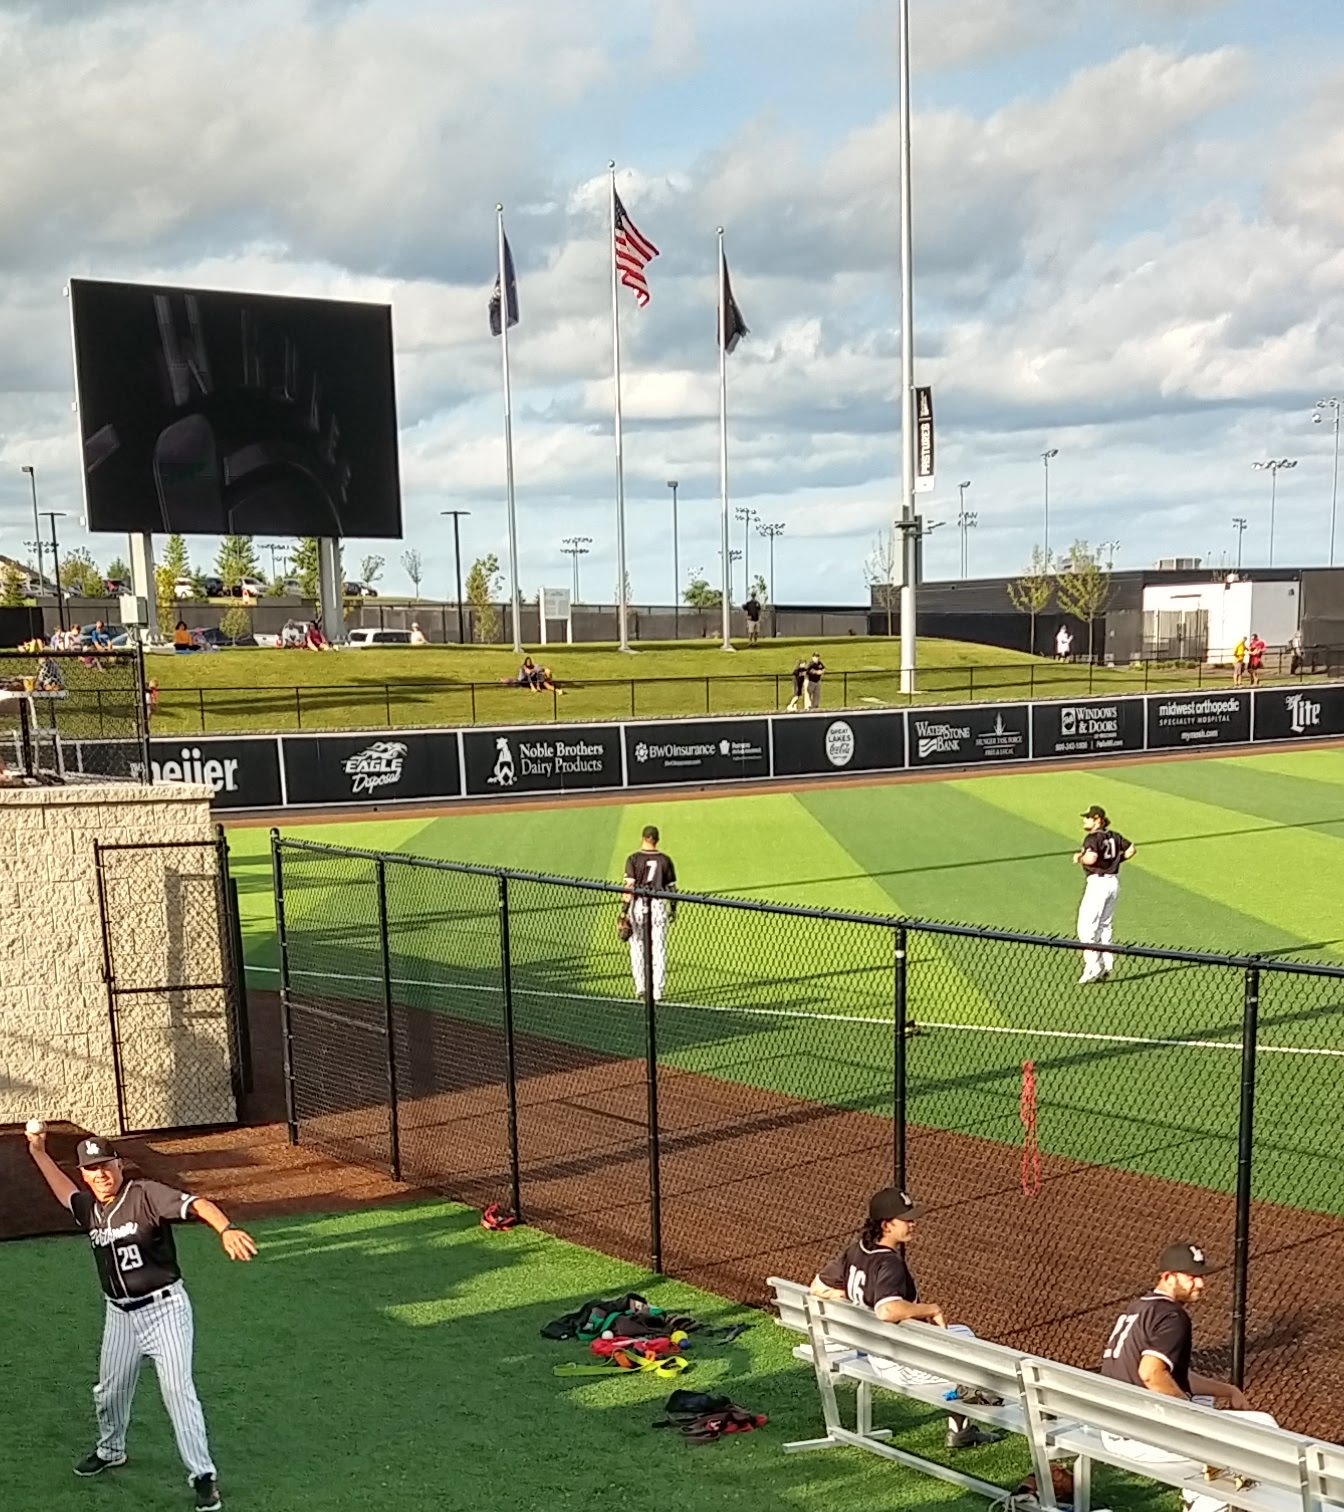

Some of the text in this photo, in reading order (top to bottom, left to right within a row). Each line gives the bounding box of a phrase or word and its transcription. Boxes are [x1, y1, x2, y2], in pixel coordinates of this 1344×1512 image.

[1076, 707, 1118, 720] WINDOWS
[1159, 697, 1240, 716] midwest orthopedic
[1159, 715, 1230, 726] SPECIALTY HOSPITAL
[1290, 700, 1321, 732] Lite
[1078, 720, 1118, 734] & DOORS
[828, 735, 851, 743] LAKES
[937, 736, 960, 752] BANK
[519, 741, 604, 758] Noble Brothers
[345, 758, 403, 774] EAGLE
[521, 756, 603, 778] Dairy Products
[1103, 838, 1116, 860] 21
[646, 860, 658, 883] 7
[116, 1244, 144, 1272] 29
[847, 1264, 866, 1306] 16
